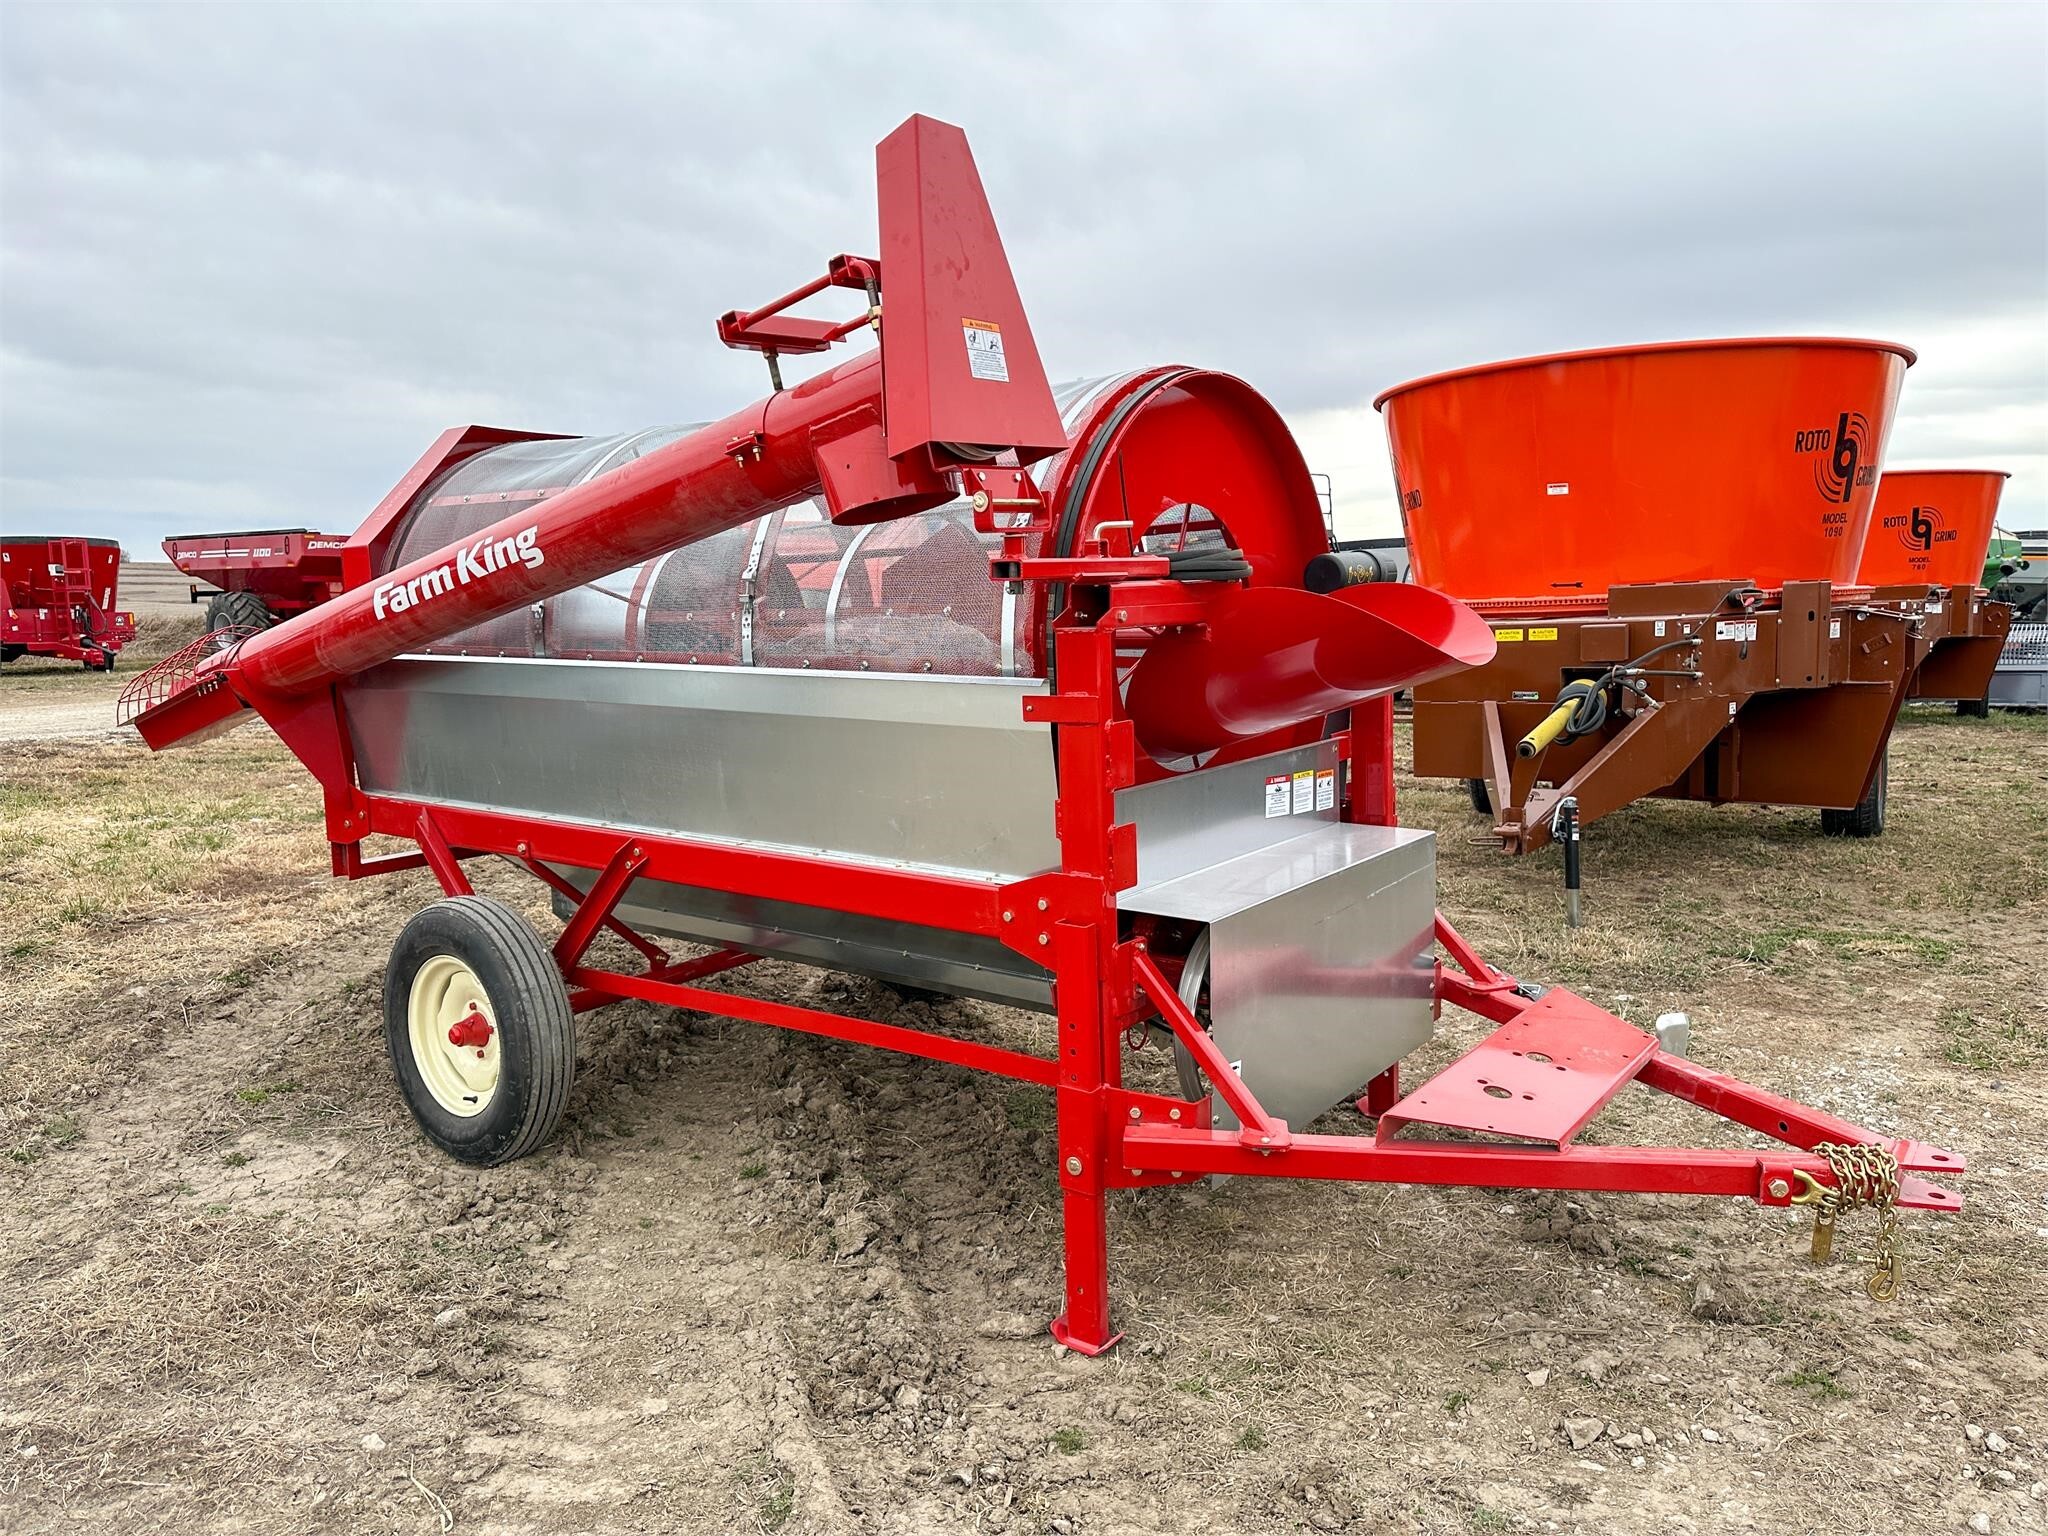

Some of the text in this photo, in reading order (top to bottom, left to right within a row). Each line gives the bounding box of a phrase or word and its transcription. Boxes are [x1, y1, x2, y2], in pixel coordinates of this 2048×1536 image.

[1795, 429, 1831, 453] ROTO
[1404, 489, 1422, 511] GRIND
[1822, 512, 1848, 525] MODEL
[1883, 516, 1908, 528] ROTO
[1824, 526, 1843, 538] 1090
[1934, 530, 1957, 543] GRIND
[177, 551, 197, 560] DEMCO
[253, 548, 272, 558] 1100
[373, 525, 545, 620] Farm King
